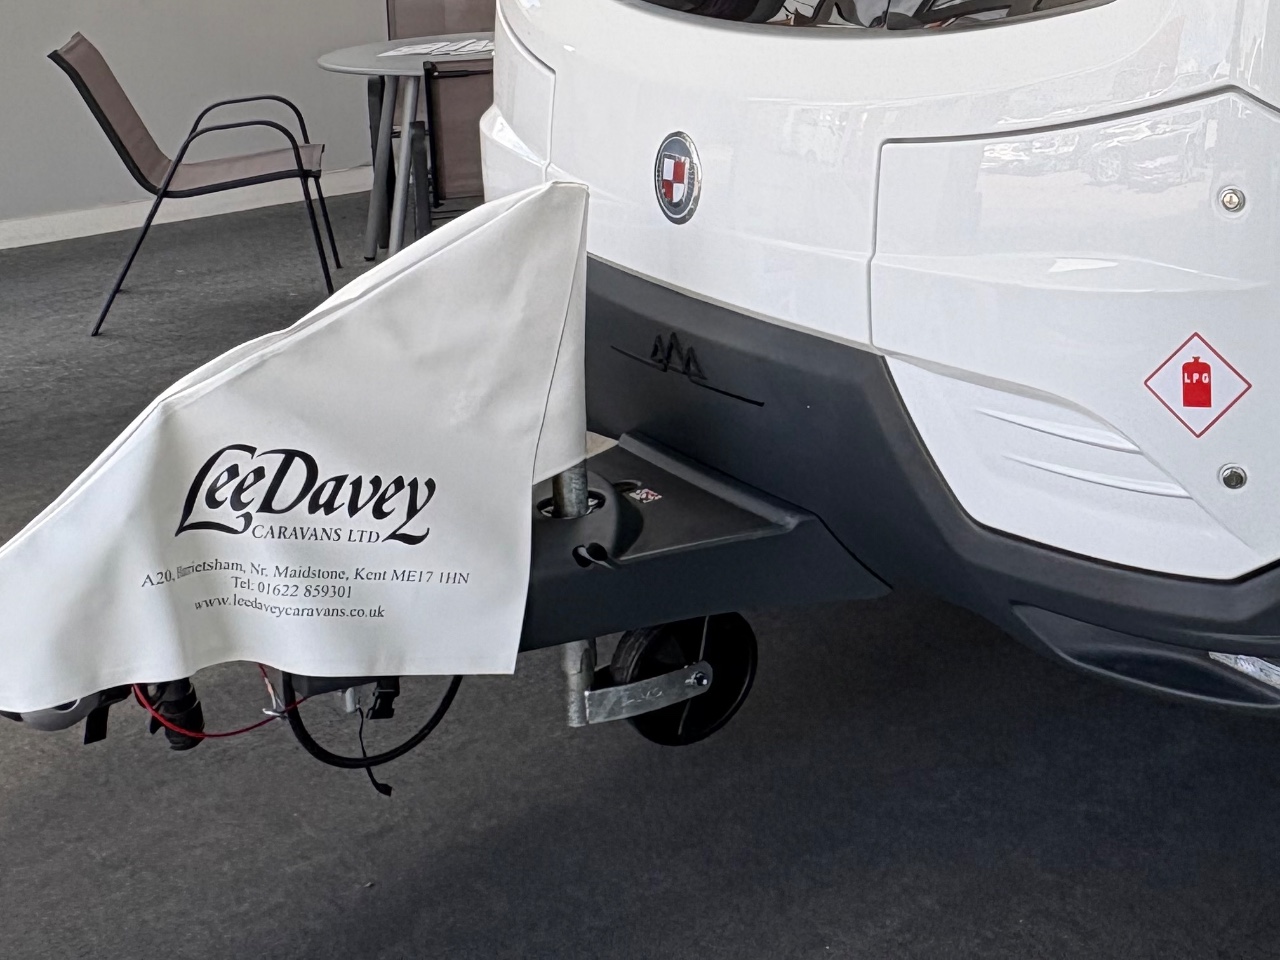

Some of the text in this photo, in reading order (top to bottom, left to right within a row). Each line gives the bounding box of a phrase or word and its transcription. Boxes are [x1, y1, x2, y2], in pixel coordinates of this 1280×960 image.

[1184, 372, 1209, 384] LPG
[251, 524, 381, 544] CARAVANS LTD
[250, 561, 269, 578] Nr.
[273, 565, 350, 582] Maidstone,
[353, 567, 387, 582] Kent
[391, 568, 434, 583] ME17
[439, 571, 470, 585] 1HN
[257, 581, 299, 598] 01622
[303, 584, 352, 599] 859301
[194, 593, 386, 618] www.leedaveycaravans.co.uk
